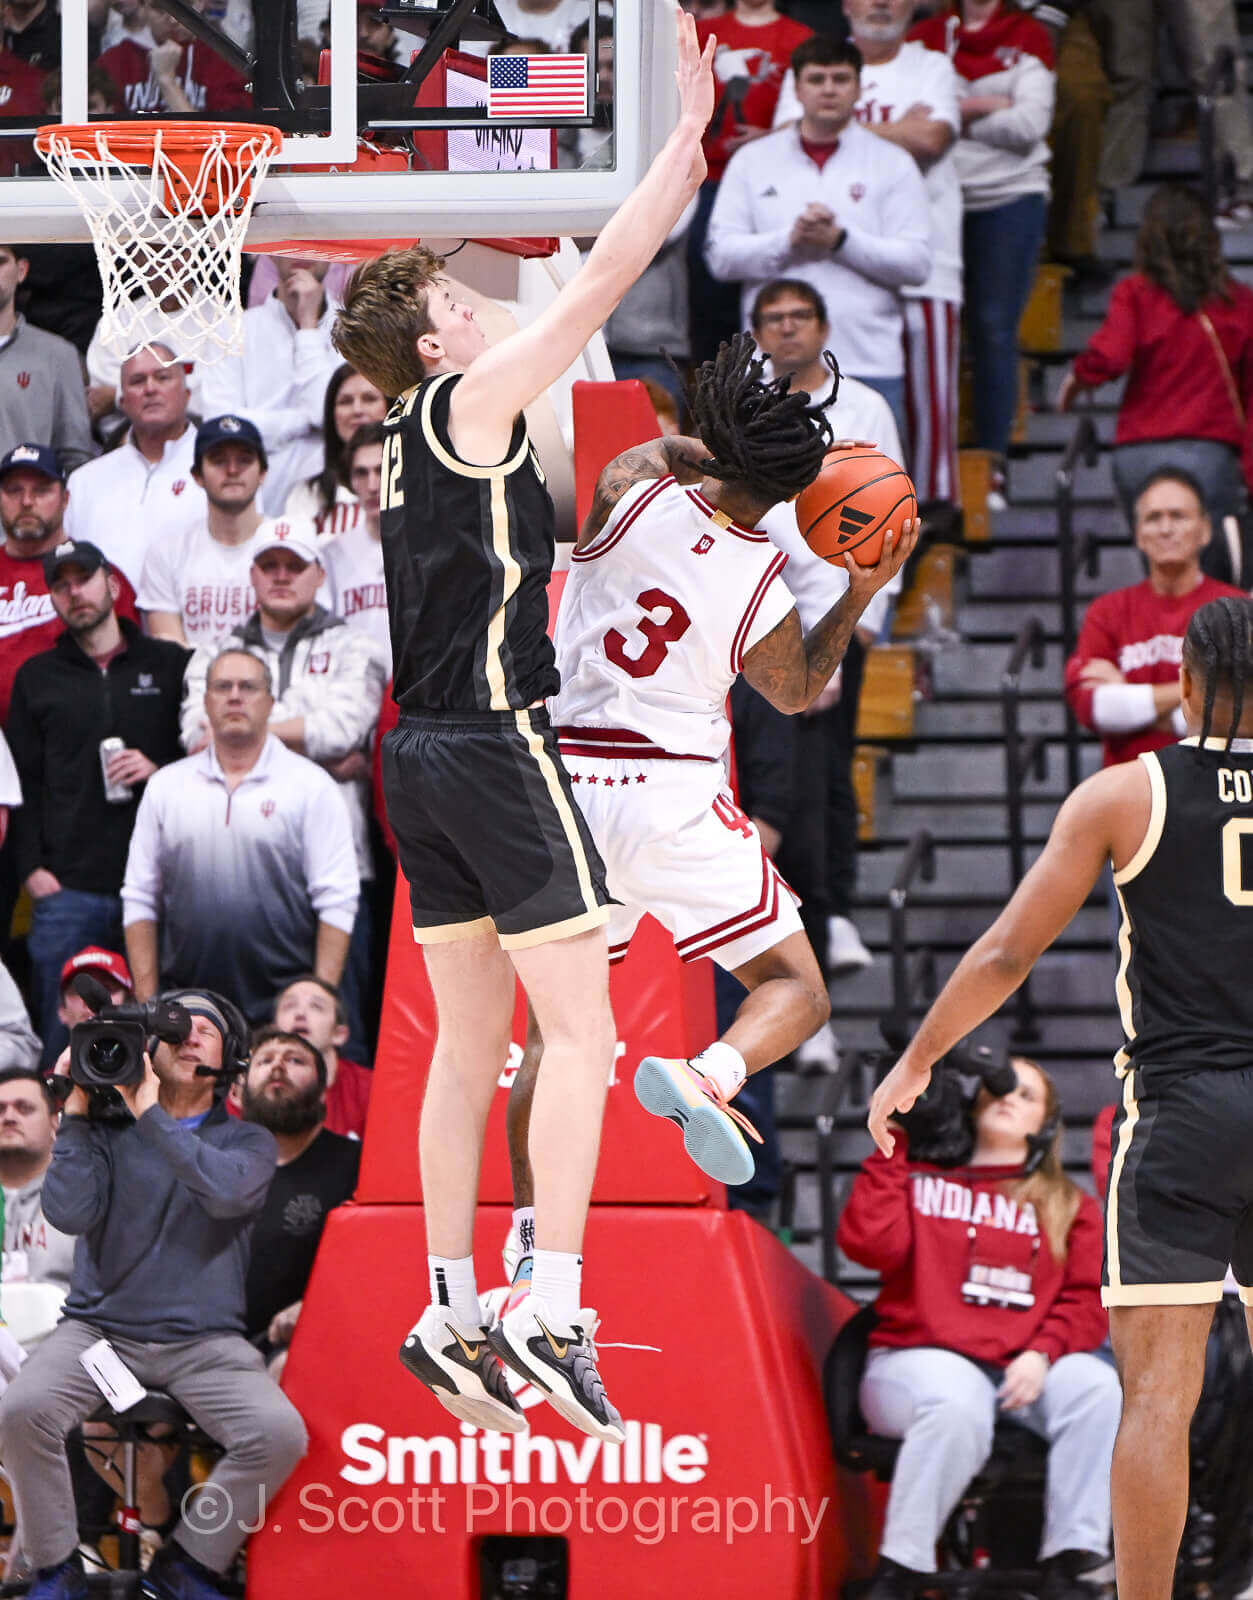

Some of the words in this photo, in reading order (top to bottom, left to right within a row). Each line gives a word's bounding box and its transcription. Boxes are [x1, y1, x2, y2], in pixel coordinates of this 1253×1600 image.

[379, 432, 405, 512] 12
[603, 587, 692, 678] 3
[1217, 767, 1253, 803] CO
[914, 1175, 1039, 1237] INDIANA
[339, 1420, 709, 1485] Smithville
